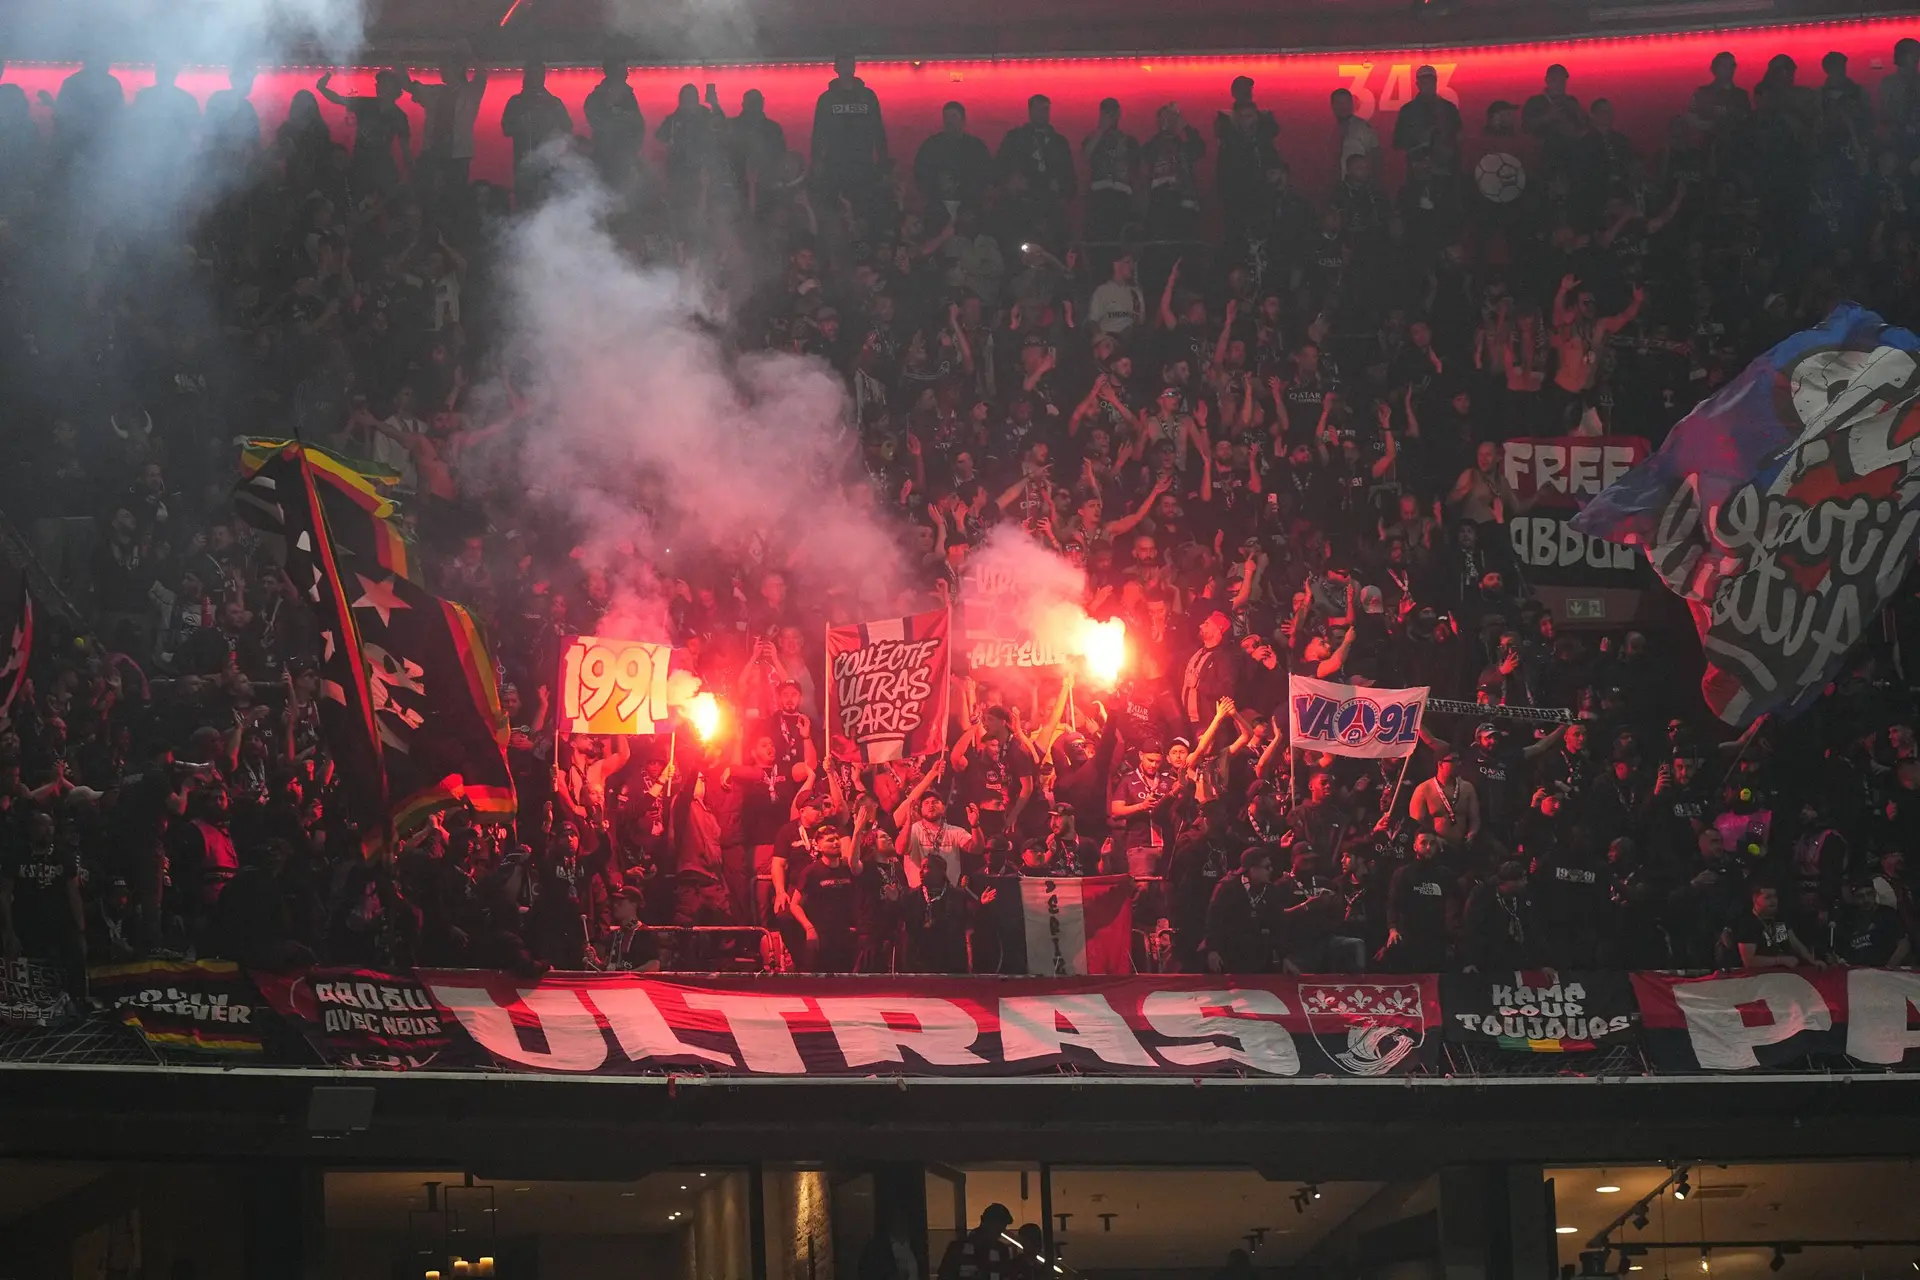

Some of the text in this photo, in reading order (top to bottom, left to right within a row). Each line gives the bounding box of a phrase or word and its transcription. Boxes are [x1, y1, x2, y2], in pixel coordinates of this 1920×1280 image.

[1503, 441, 1634, 494] FREE
[564, 643, 672, 722] 1991
[839, 666, 931, 706] ULTRAS
[1492, 982, 1586, 1006] KAMA
[325, 1008, 442, 1036] AVEC NOUS
[430, 984, 1300, 1076] ULTRAS
[1455, 1012, 1631, 1041] TOUJOURS
